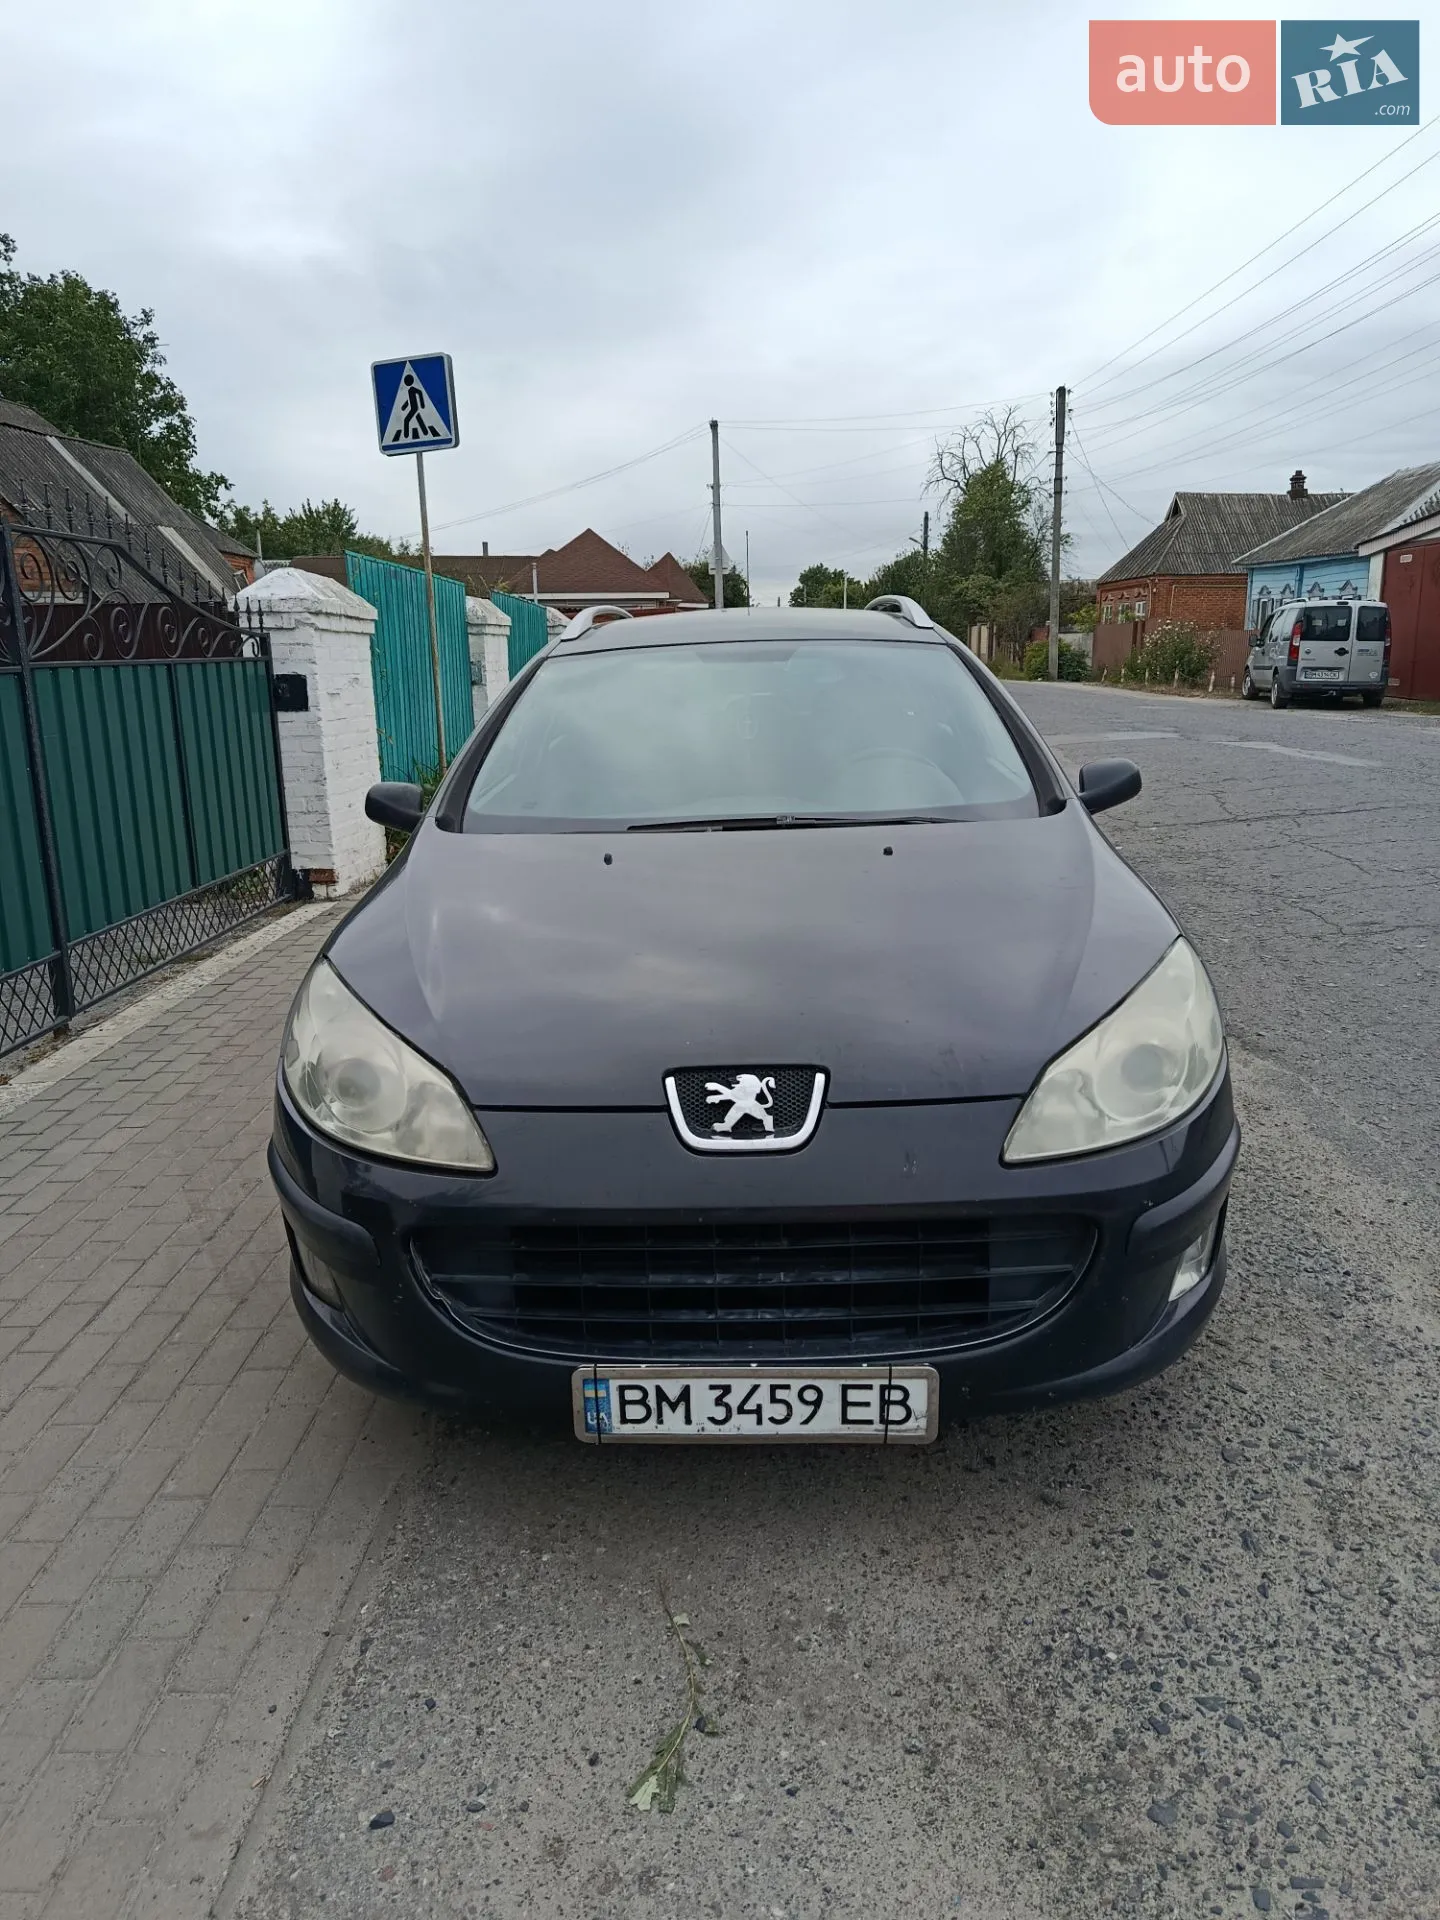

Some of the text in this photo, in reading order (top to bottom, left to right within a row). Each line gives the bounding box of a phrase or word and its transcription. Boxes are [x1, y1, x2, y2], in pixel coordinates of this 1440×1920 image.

[618, 1383, 913, 1427] BM 3459 EB
